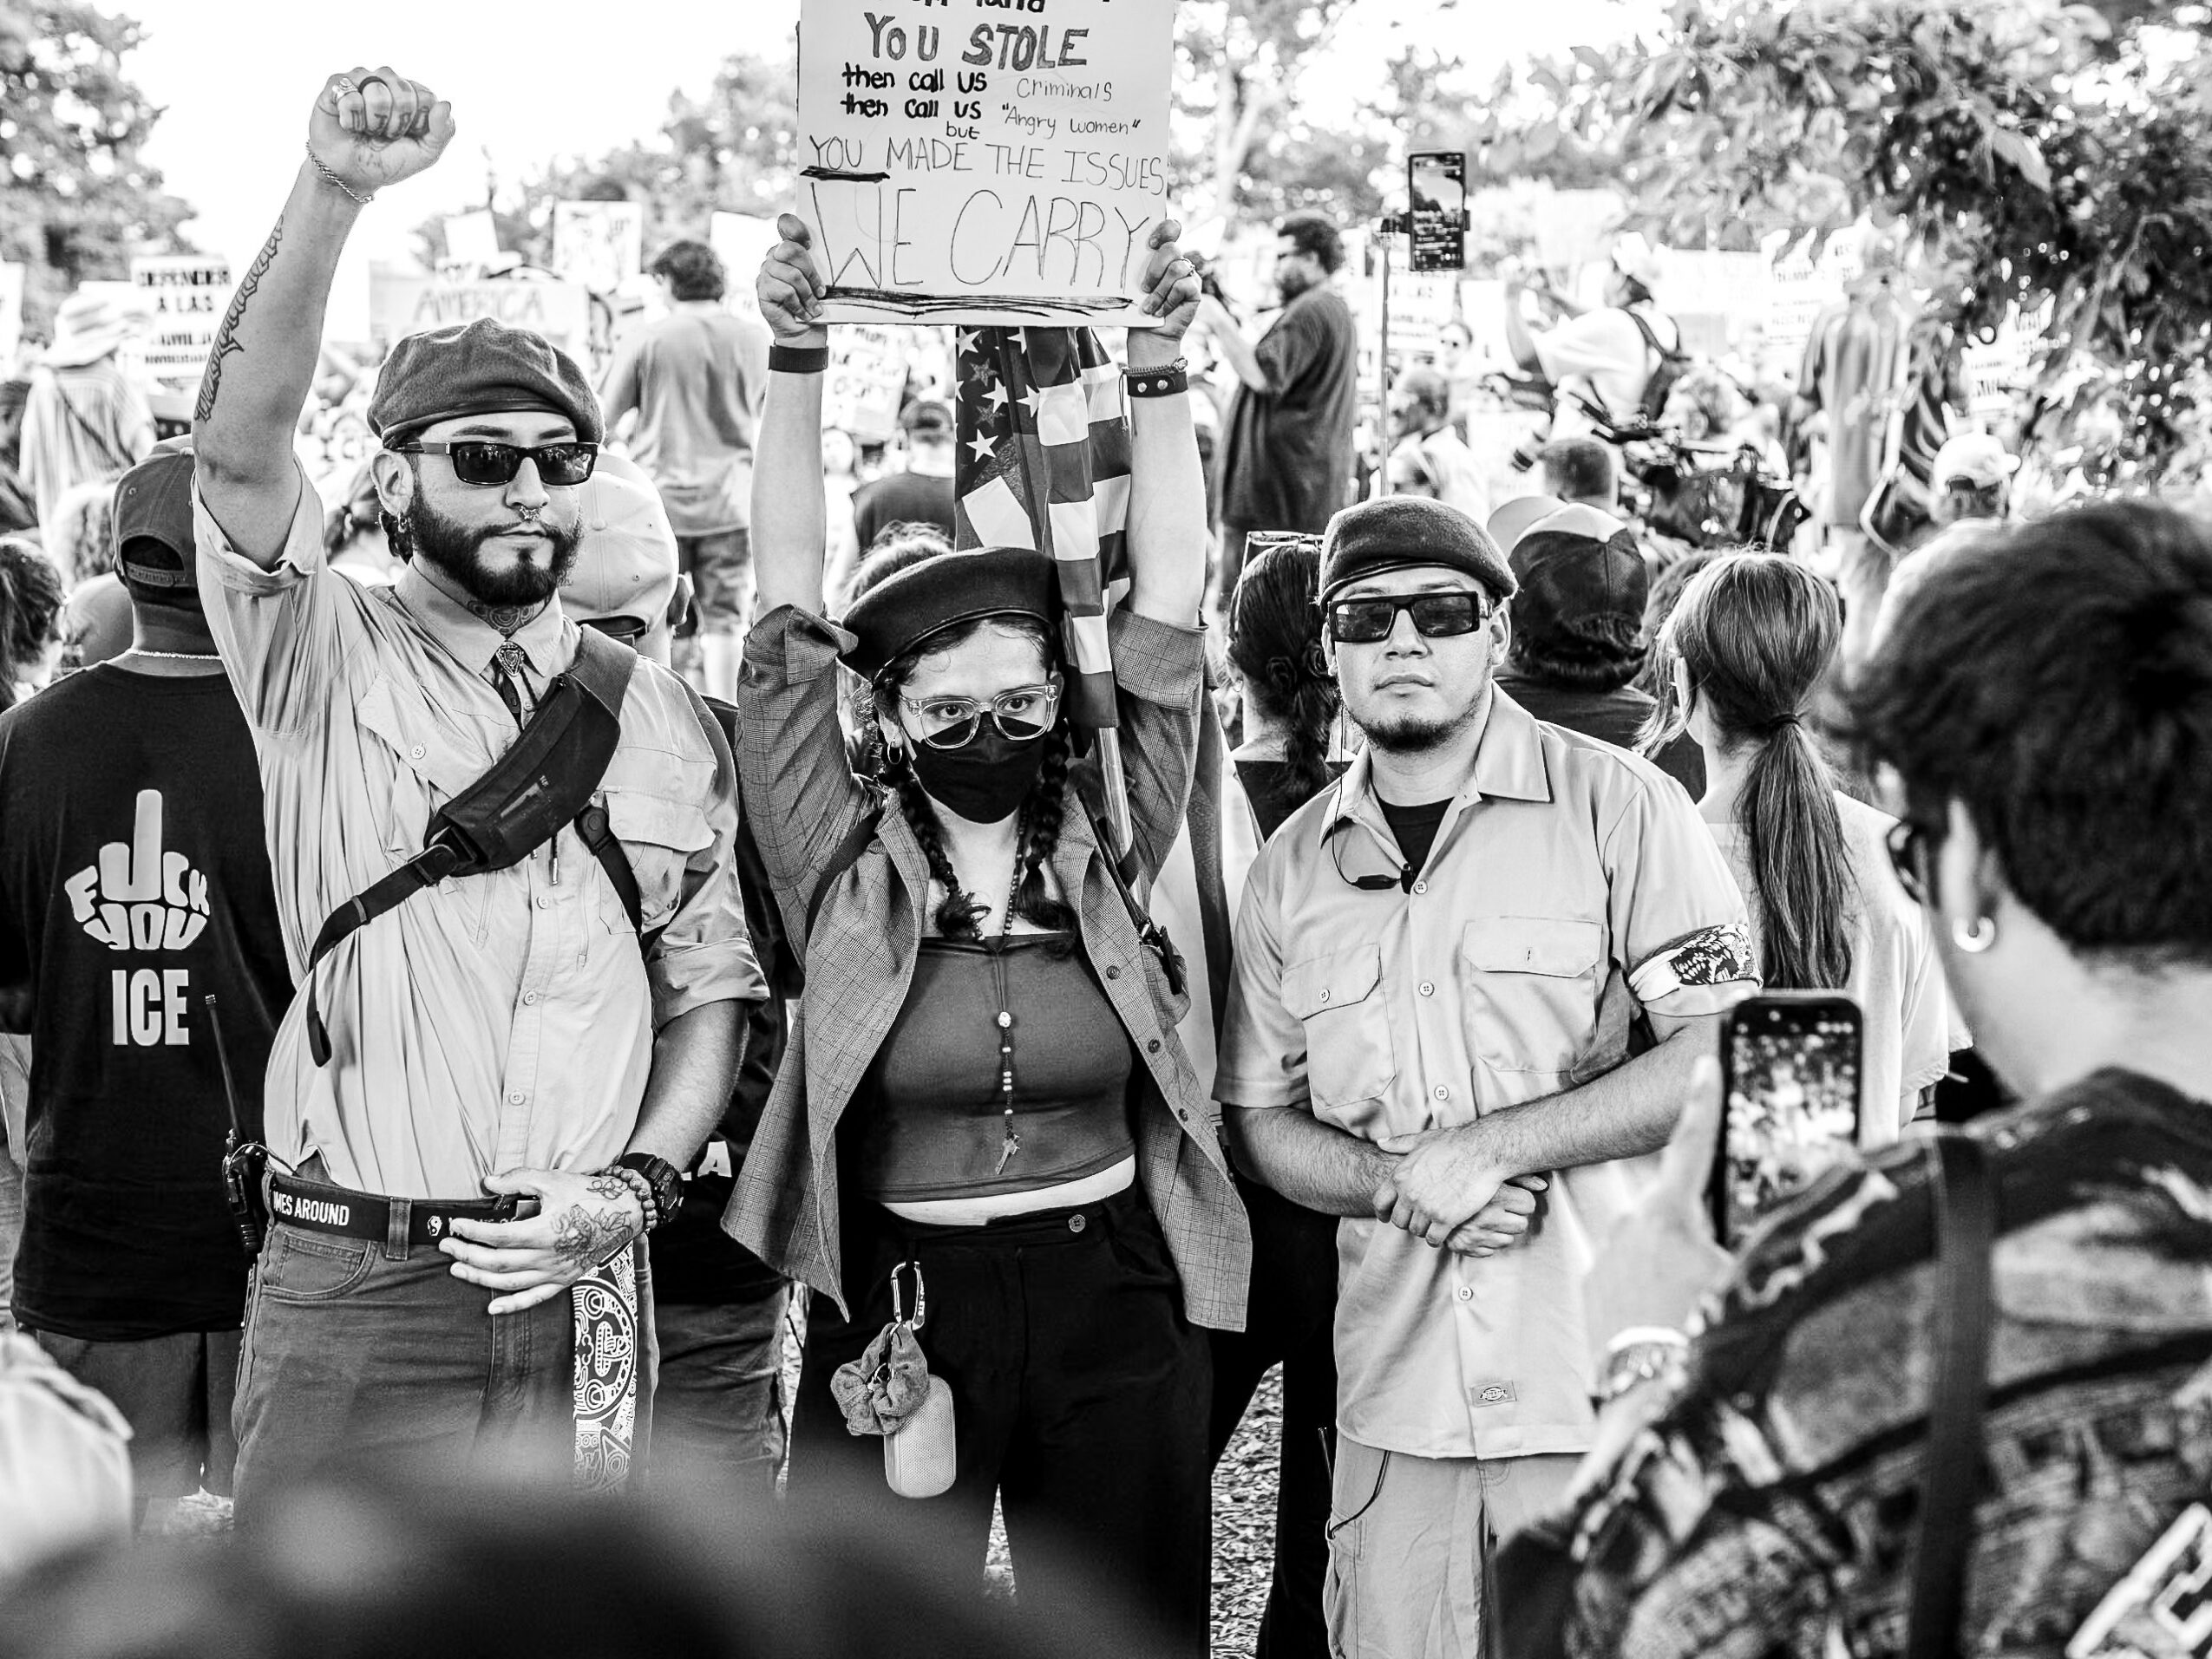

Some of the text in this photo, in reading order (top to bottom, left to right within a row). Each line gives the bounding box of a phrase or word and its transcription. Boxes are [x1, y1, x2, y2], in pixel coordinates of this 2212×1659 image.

[865, 12, 1089, 71] YOU STOLE
[841, 62, 895, 89] then
[908, 68, 945, 93] call
[840, 91, 889, 118] then
[904, 98, 939, 119] call
[1002, 101, 1057, 140] "Angry
[1070, 117, 1142, 135] women"
[946, 120, 980, 140] but
[809, 134, 1164, 196] YOU MADE THE ISSUES
[810, 181, 1150, 294] WE CARRY
[64, 789, 210, 923] FUCK
[82, 903, 208, 950] YOU
[111, 969, 190, 1047] ICE
[294, 1197, 350, 1226] AROUND
